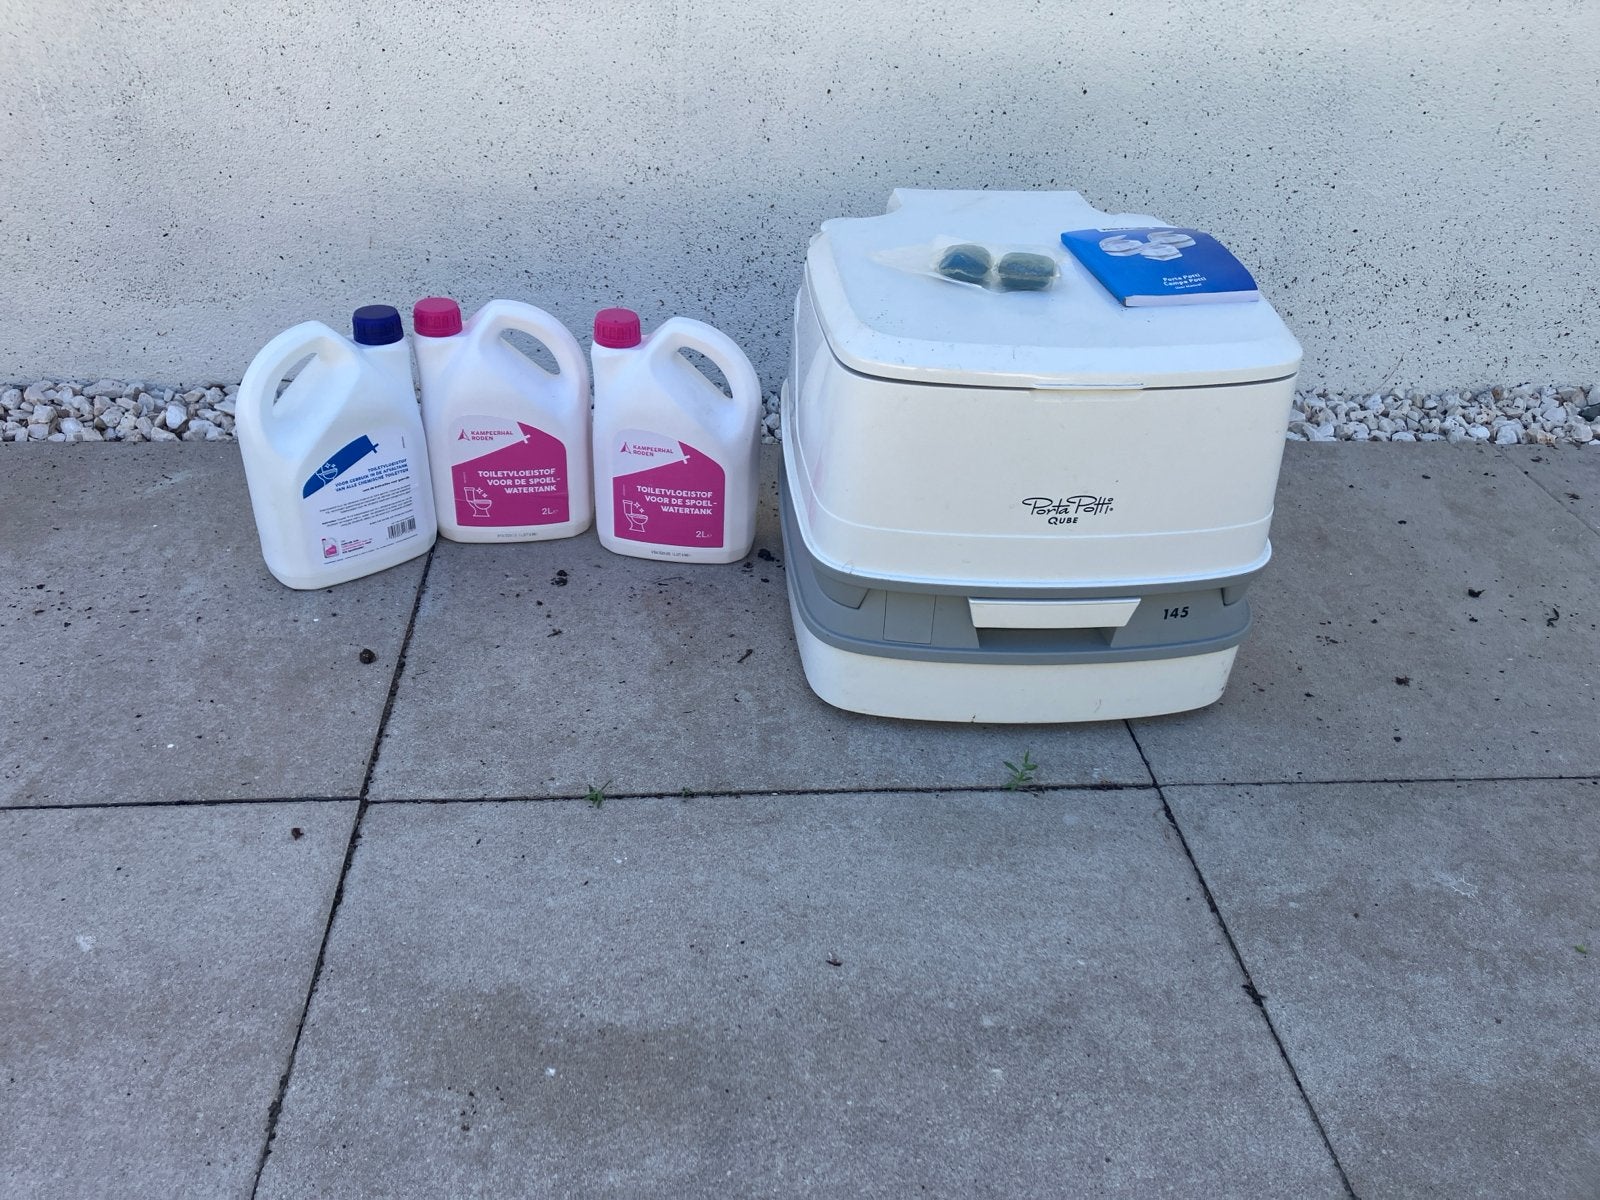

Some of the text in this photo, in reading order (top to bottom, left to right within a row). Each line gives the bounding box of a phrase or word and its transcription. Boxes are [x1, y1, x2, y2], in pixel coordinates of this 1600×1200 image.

[632, 444, 674, 453] KAMPEERHAL
[632, 449, 654, 457] RODEN
[368, 458, 407, 473] TOILETVLOEISTOF
[350, 474, 369, 484] GEBRUIK
[383, 463, 408, 473] AFVALTANK
[358, 476, 384, 486] CHEMISCHE
[385, 468, 409, 478] TOILETTEN
[477, 468, 556, 477] TOILETVLOEISTOF
[487, 478, 513, 486] VOOR
[528, 476, 561, 484] SPOEL-
[504, 485, 557, 494] WATERTANK
[636, 485, 713, 498] TOILETVLOEISTOF
[644, 495, 669, 503] VOOR
[685, 499, 717, 507] SPOEL-
[1021, 495, 1114, 516] Porta Potti
[660, 505, 713, 515] WATERTANK
[1047, 516, 1079, 526] QUBE
[1162, 605, 1190, 620] 145
